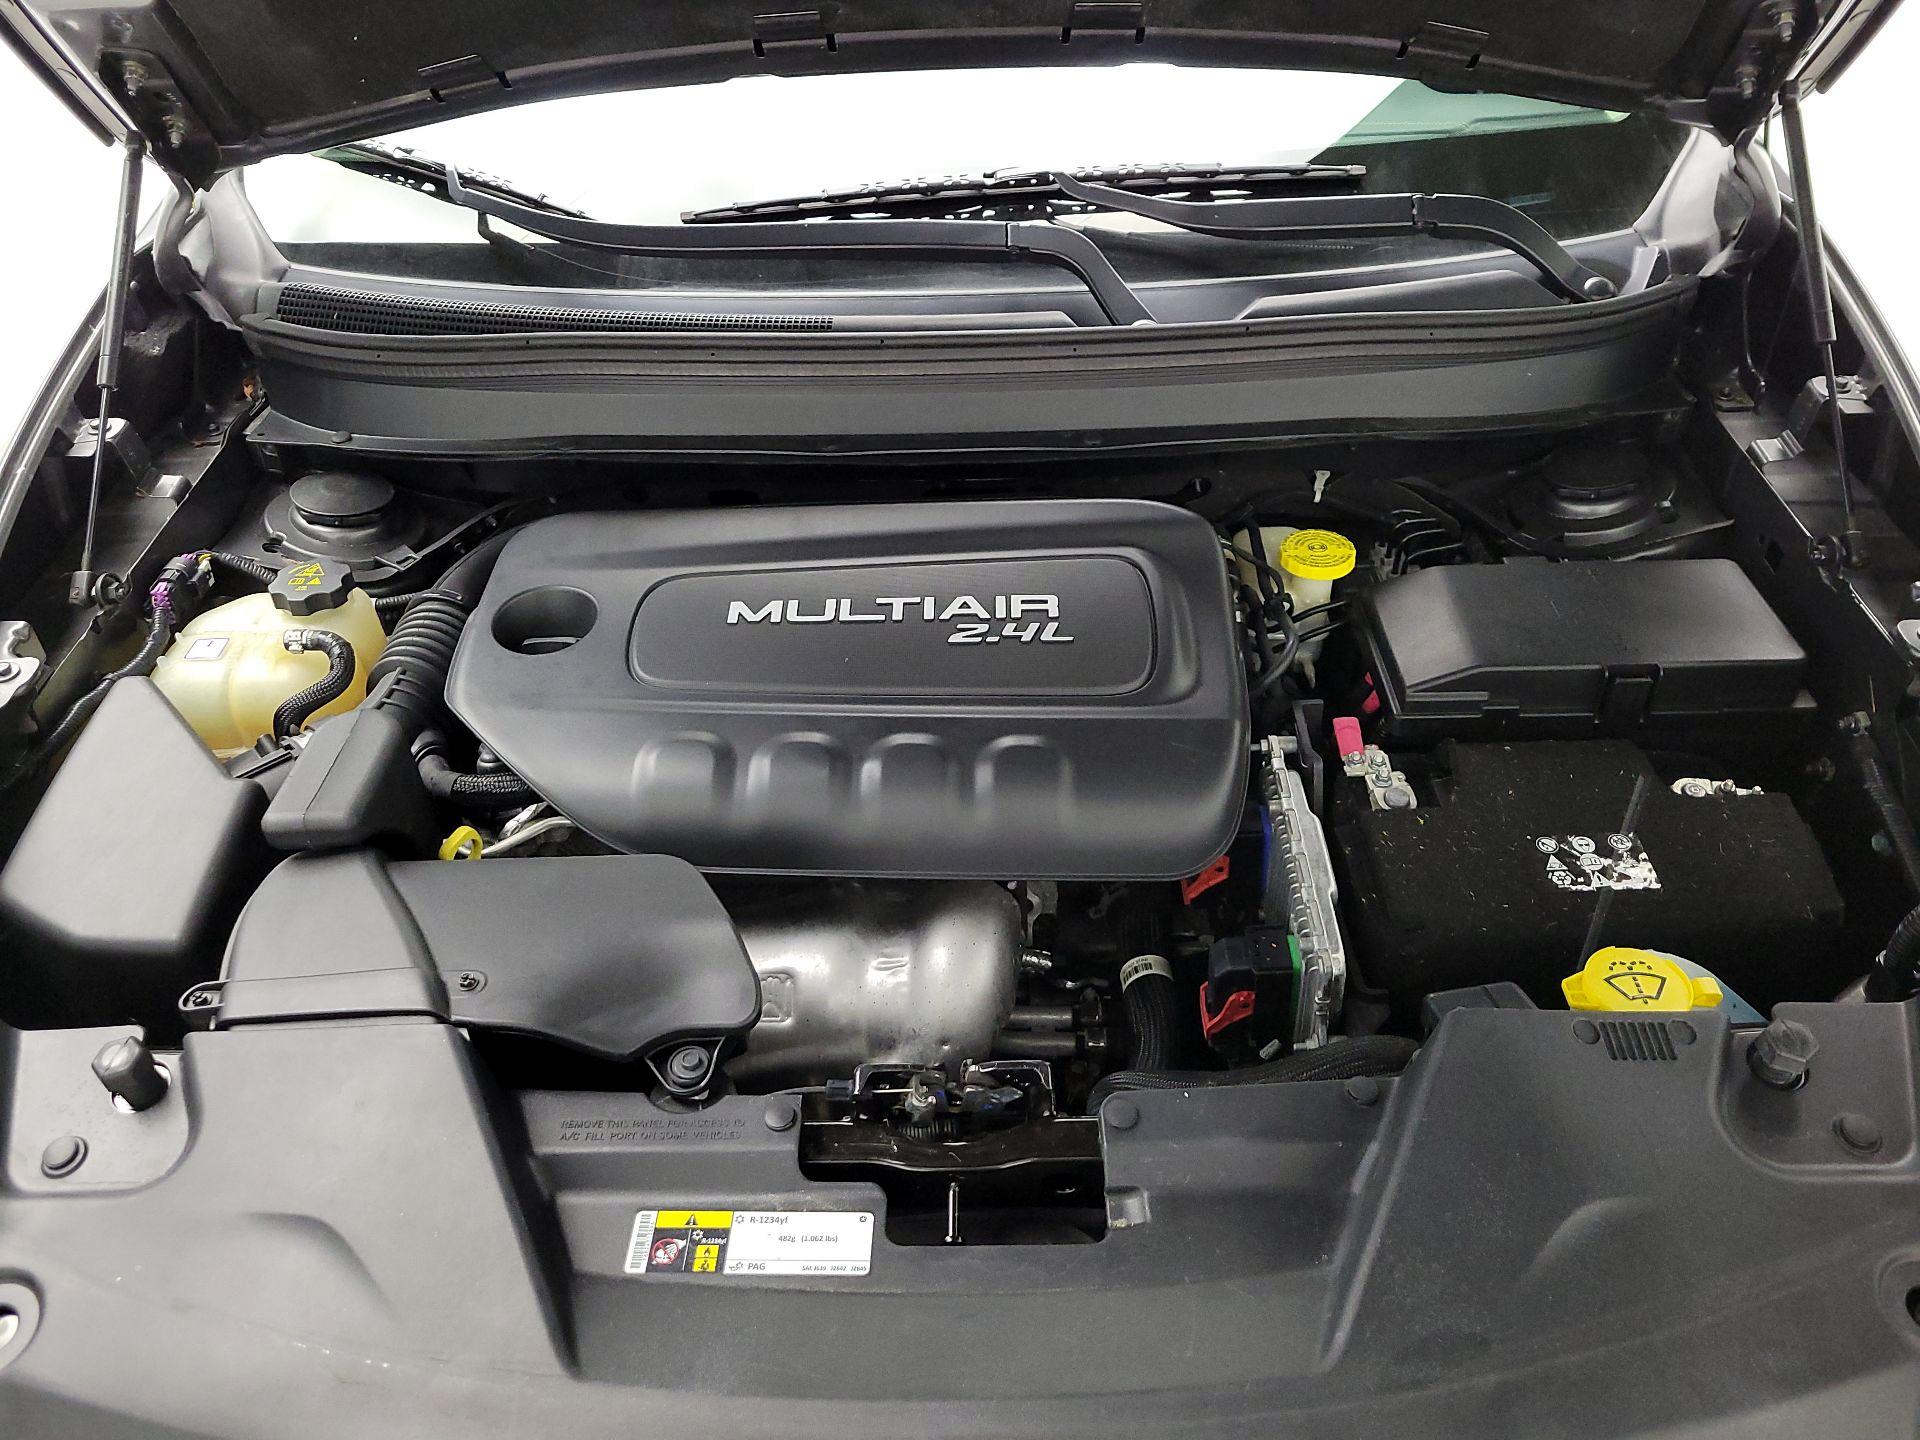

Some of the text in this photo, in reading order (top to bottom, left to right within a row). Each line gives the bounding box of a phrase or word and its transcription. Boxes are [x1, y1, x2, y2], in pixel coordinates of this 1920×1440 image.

[726, 594, 1060, 625] MULTIAIR
[947, 621, 1075, 644] 2.4L
[560, 1120, 604, 1129] REMOVE
[607, 1120, 628, 1129] THIS
[632, 1120, 664, 1129] PANEL
[667, 1119, 688, 1128] FOR
[560, 1132, 580, 1141] A/C
[585, 1132, 605, 1141] FILL
[609, 1132, 637, 1141] PORT
[658, 1131, 688, 1140] SOME
[693, 1131, 741, 1140] VEHICLES
[749, 1215, 789, 1225] R-1234yf
[778, 1235, 838, 1243] 482g (1.062 lbs)
[747, 1262, 766, 1271] PAG
